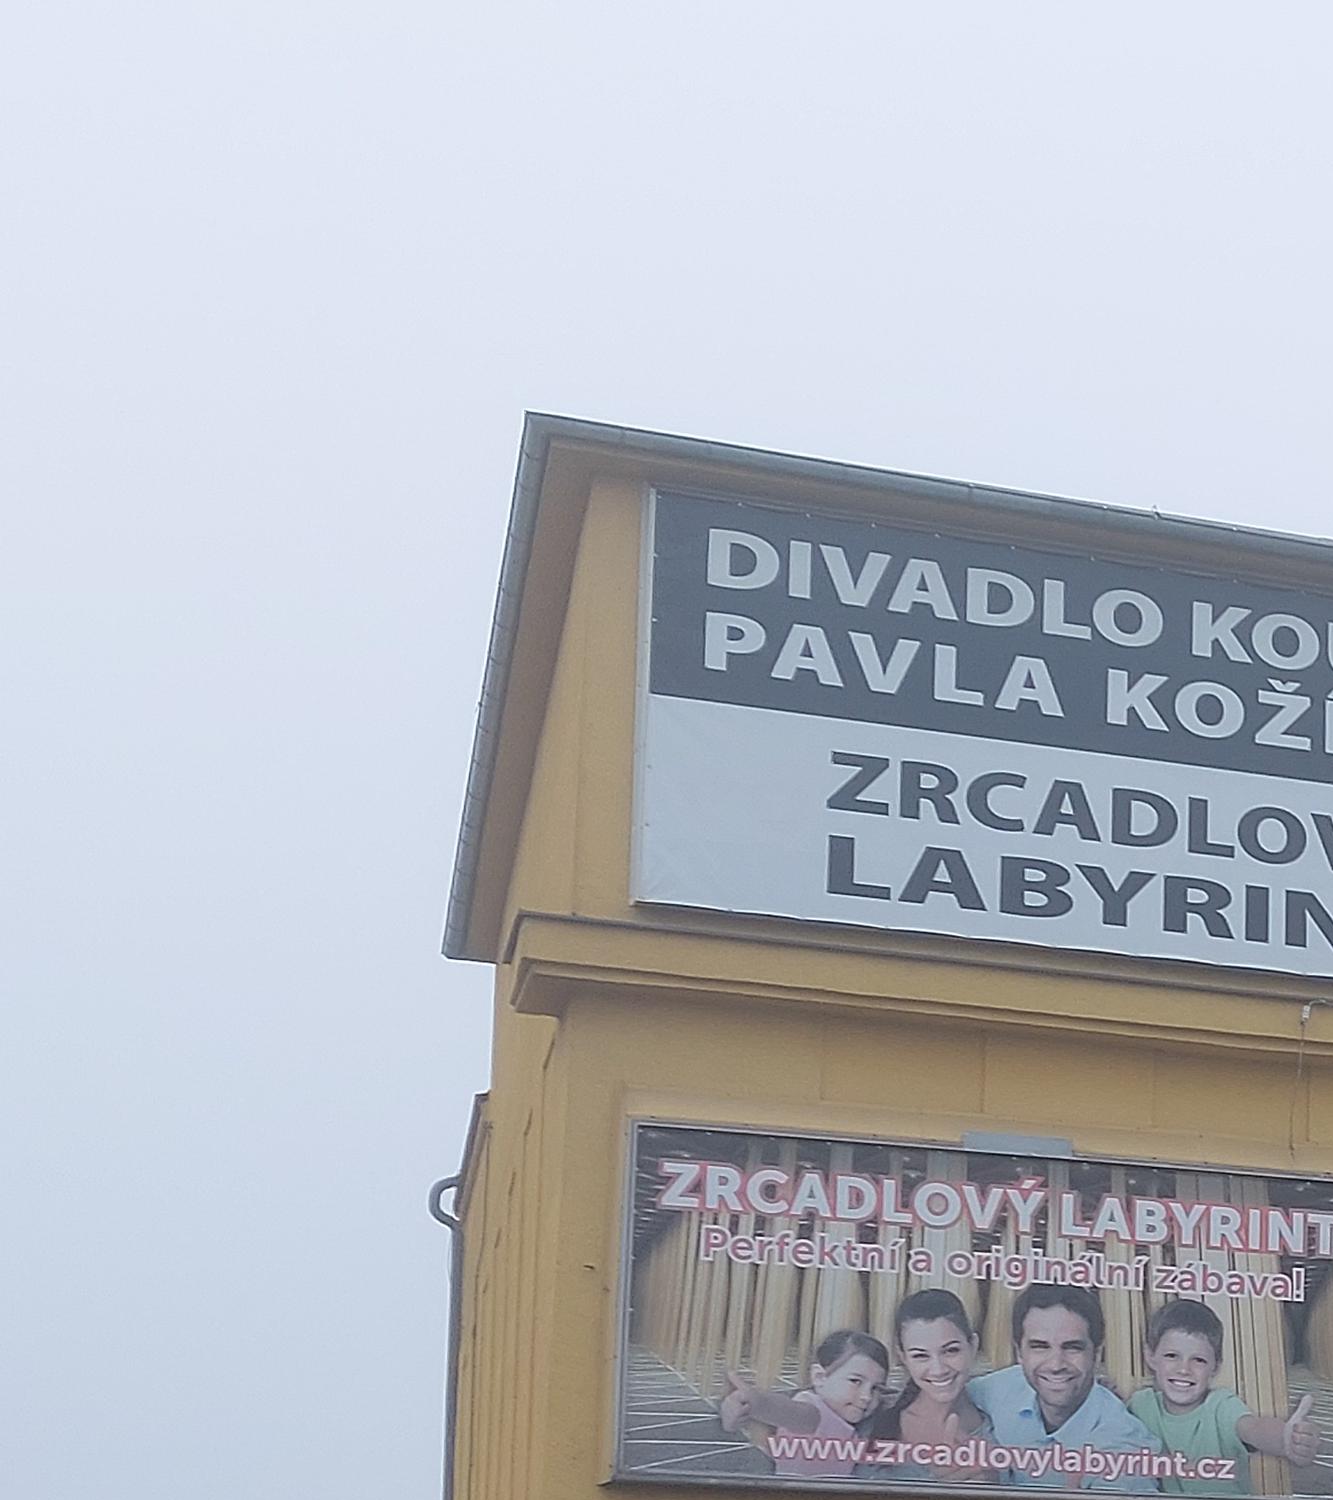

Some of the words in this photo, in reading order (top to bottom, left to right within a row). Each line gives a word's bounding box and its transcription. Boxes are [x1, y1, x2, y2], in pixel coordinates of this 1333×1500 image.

[706, 527, 1163, 649] DIVADLO
[702, 611, 1065, 718] PAVLA
[658, 1161, 1047, 1233] ZRCADLOVÝ
[700, 1225, 904, 1274] Perfektní
[909, 1249, 933, 1276] a
[945, 1244, 1145, 1291] originální
[1154, 1259, 1306, 1302] zábava!
[768, 1433, 1237, 1482] www.zrcadlovylabyrint.cz
